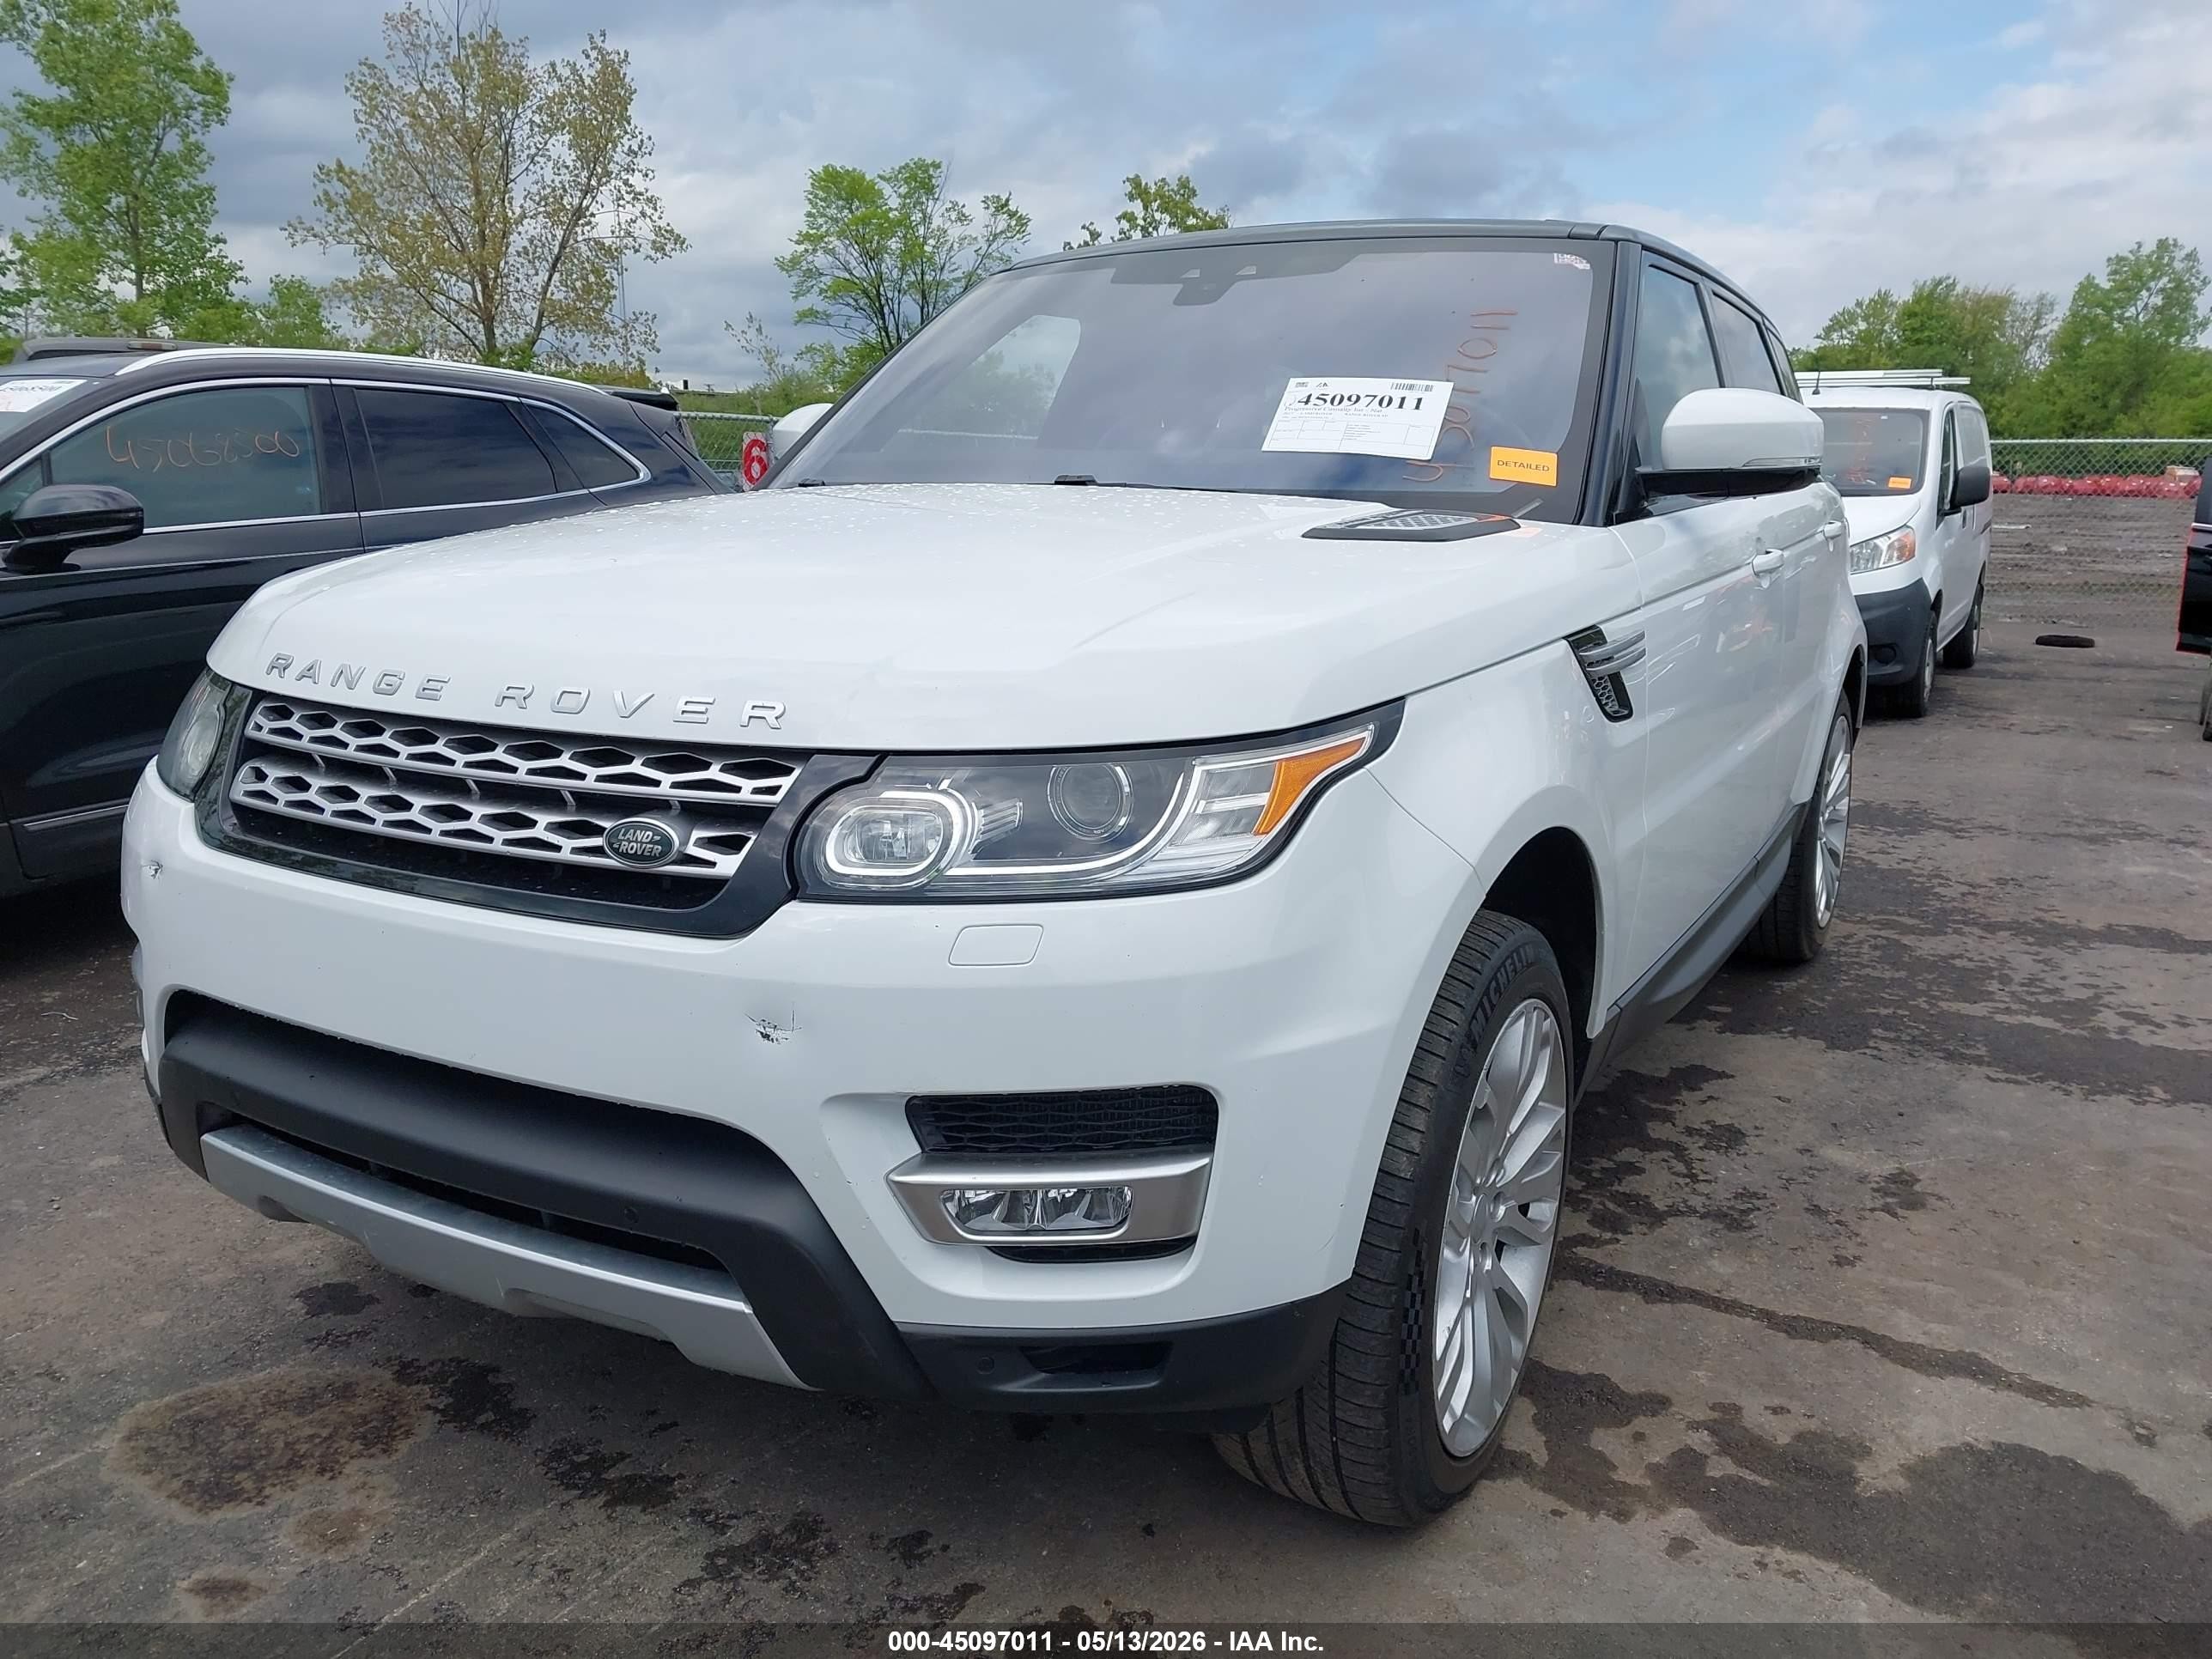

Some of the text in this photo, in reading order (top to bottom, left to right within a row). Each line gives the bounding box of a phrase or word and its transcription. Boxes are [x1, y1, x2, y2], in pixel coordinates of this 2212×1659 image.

[1297, 392, 1424, 410] 45097011
[744, 439, 769, 486] 6
[1497, 459, 1550, 472] DETAILED
[264, 653, 787, 730] RANGE ROVER
[617, 828, 653, 842] LAND
[618, 842, 662, 857] ROVER
